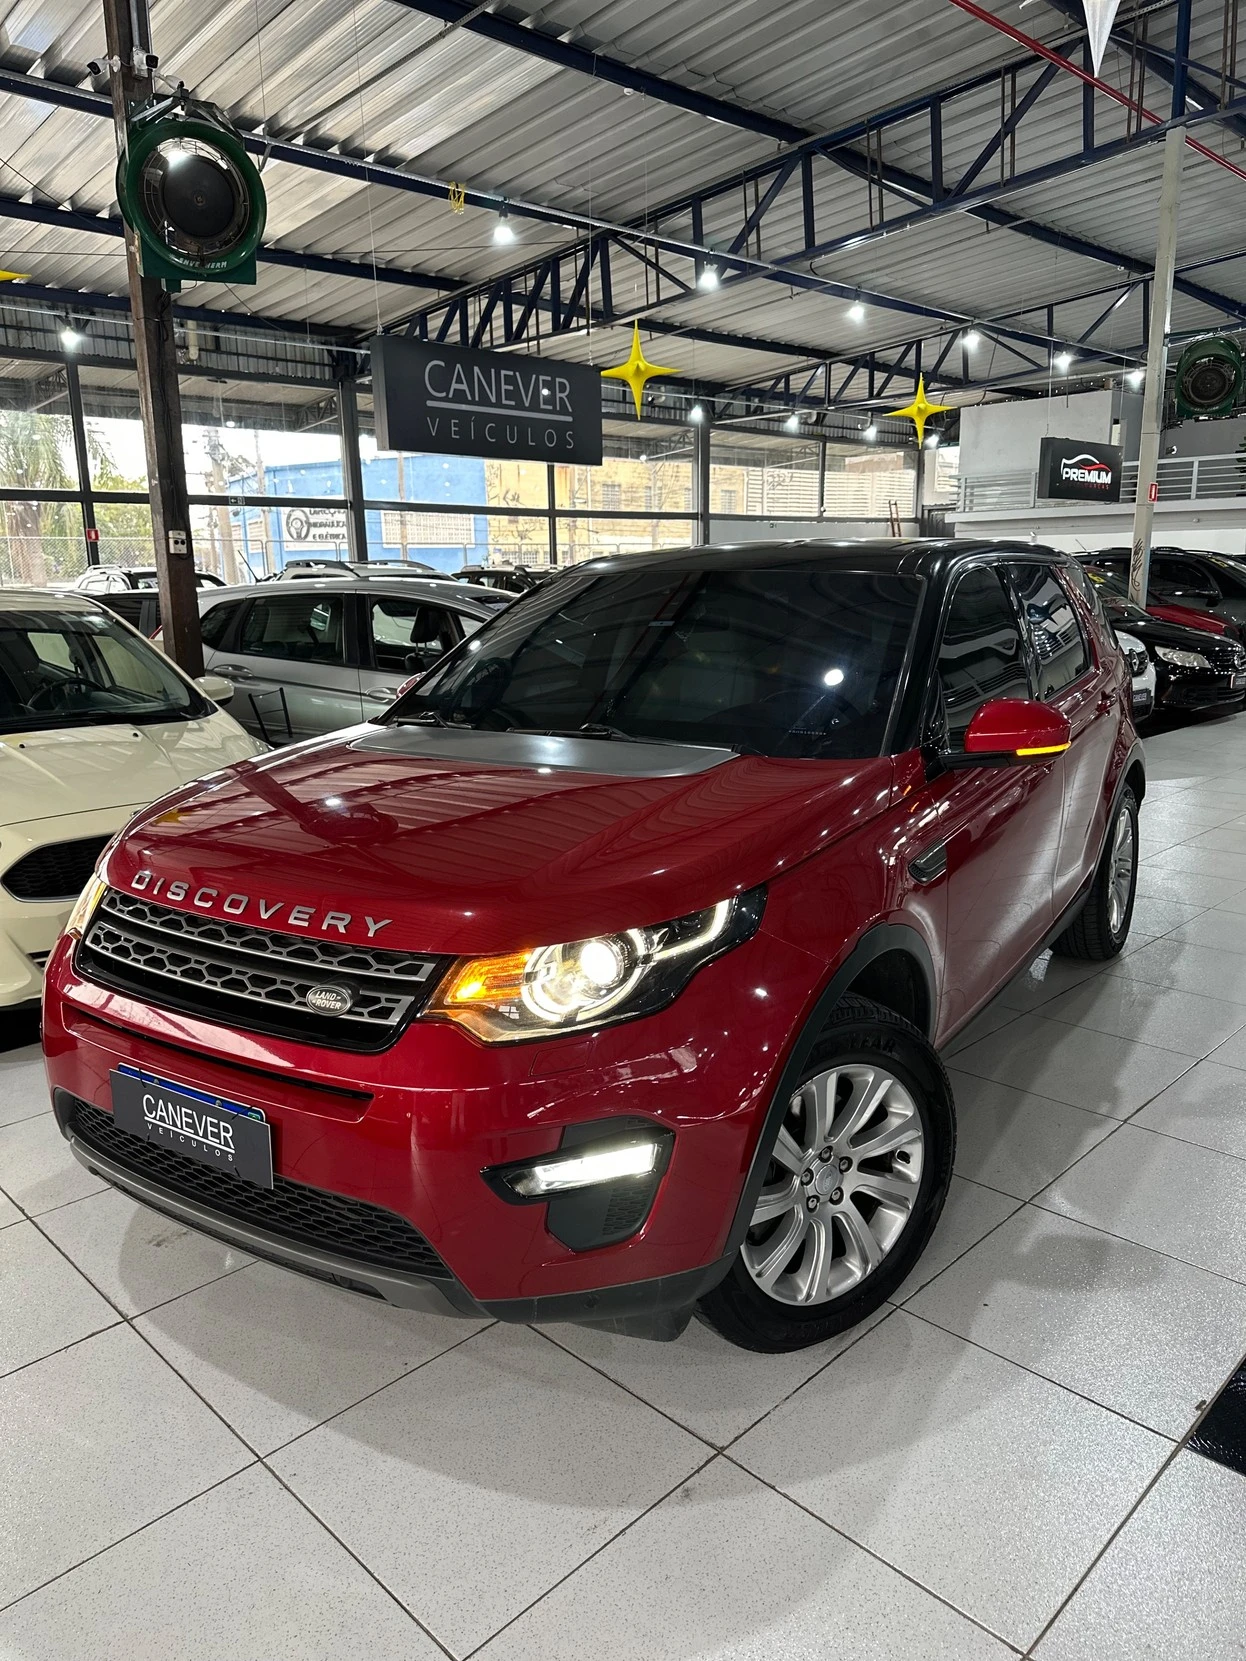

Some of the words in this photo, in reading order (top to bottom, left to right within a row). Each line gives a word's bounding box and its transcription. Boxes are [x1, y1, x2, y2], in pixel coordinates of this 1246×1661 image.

[424, 360, 573, 412] CANEVER
[427, 416, 574, 449] VEÍCULOS
[1062, 467, 1112, 485] PREMIUM
[131, 869, 394, 938] DISCOVERY
[315, 991, 337, 1001] LAND
[315, 999, 342, 1010] ROVER
[142, 1094, 235, 1149] CANEVER
[147, 1123, 233, 1162] VEICULOS
